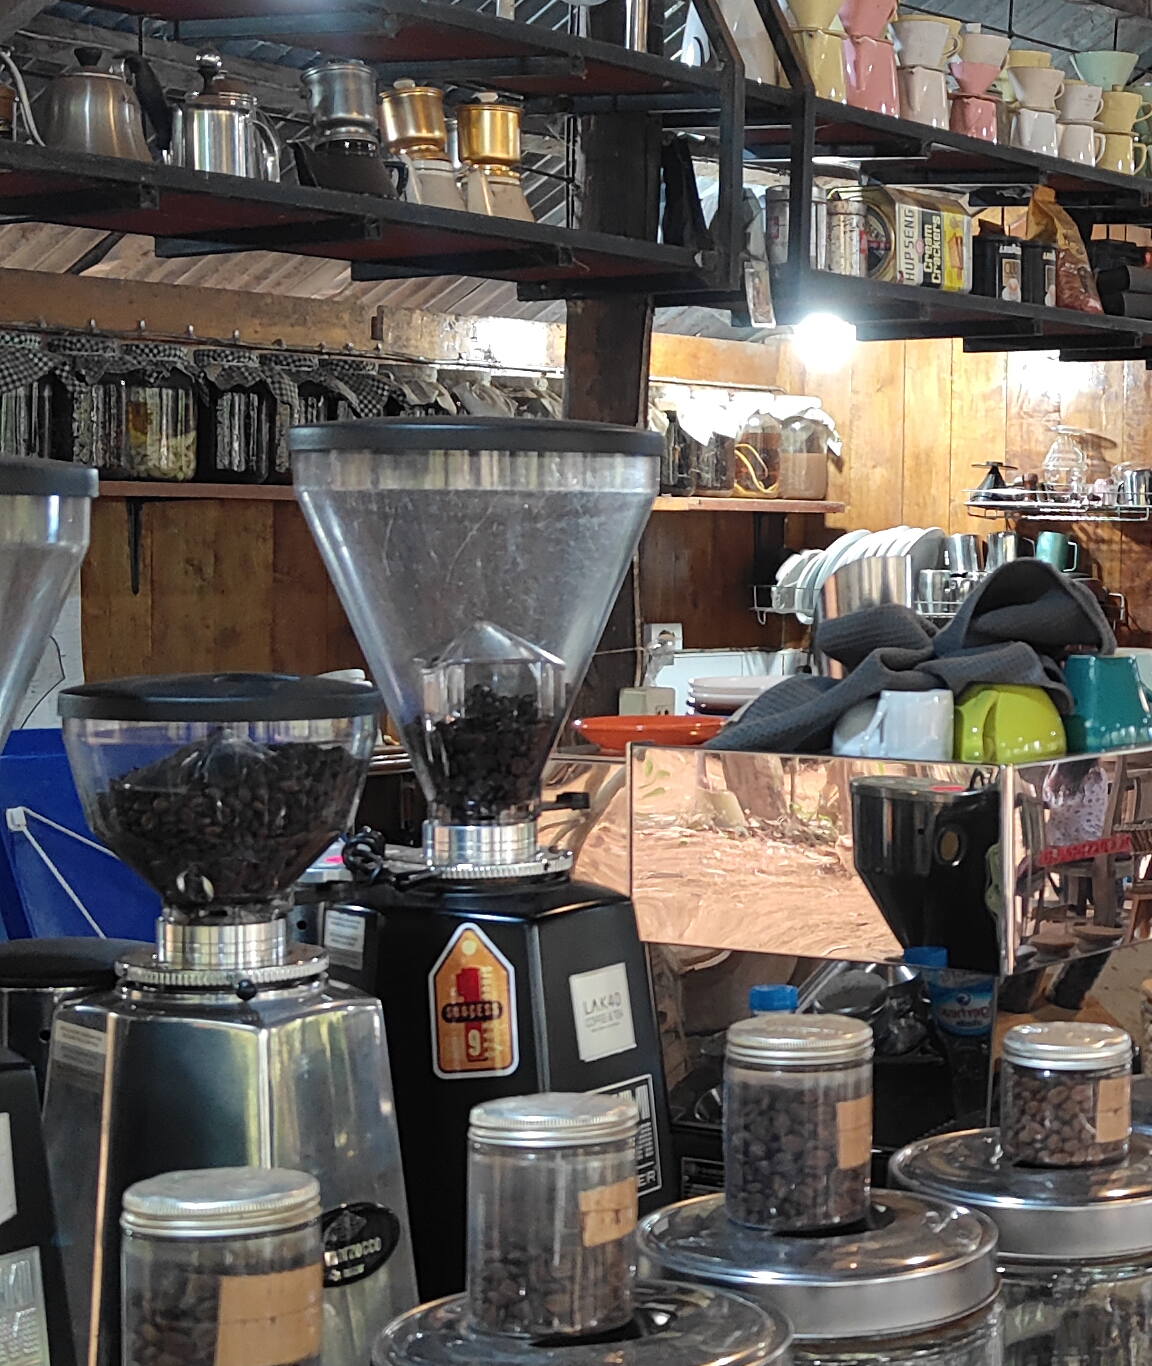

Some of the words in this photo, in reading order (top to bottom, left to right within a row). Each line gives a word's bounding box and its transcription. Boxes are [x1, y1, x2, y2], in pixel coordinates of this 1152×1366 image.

[904, 208, 915, 249] SENG
[923, 223, 933, 273] Cream
[904, 252, 915, 281] HUP
[932, 215, 941, 284] Crackers
[637, 1169, 657, 1188] ER
